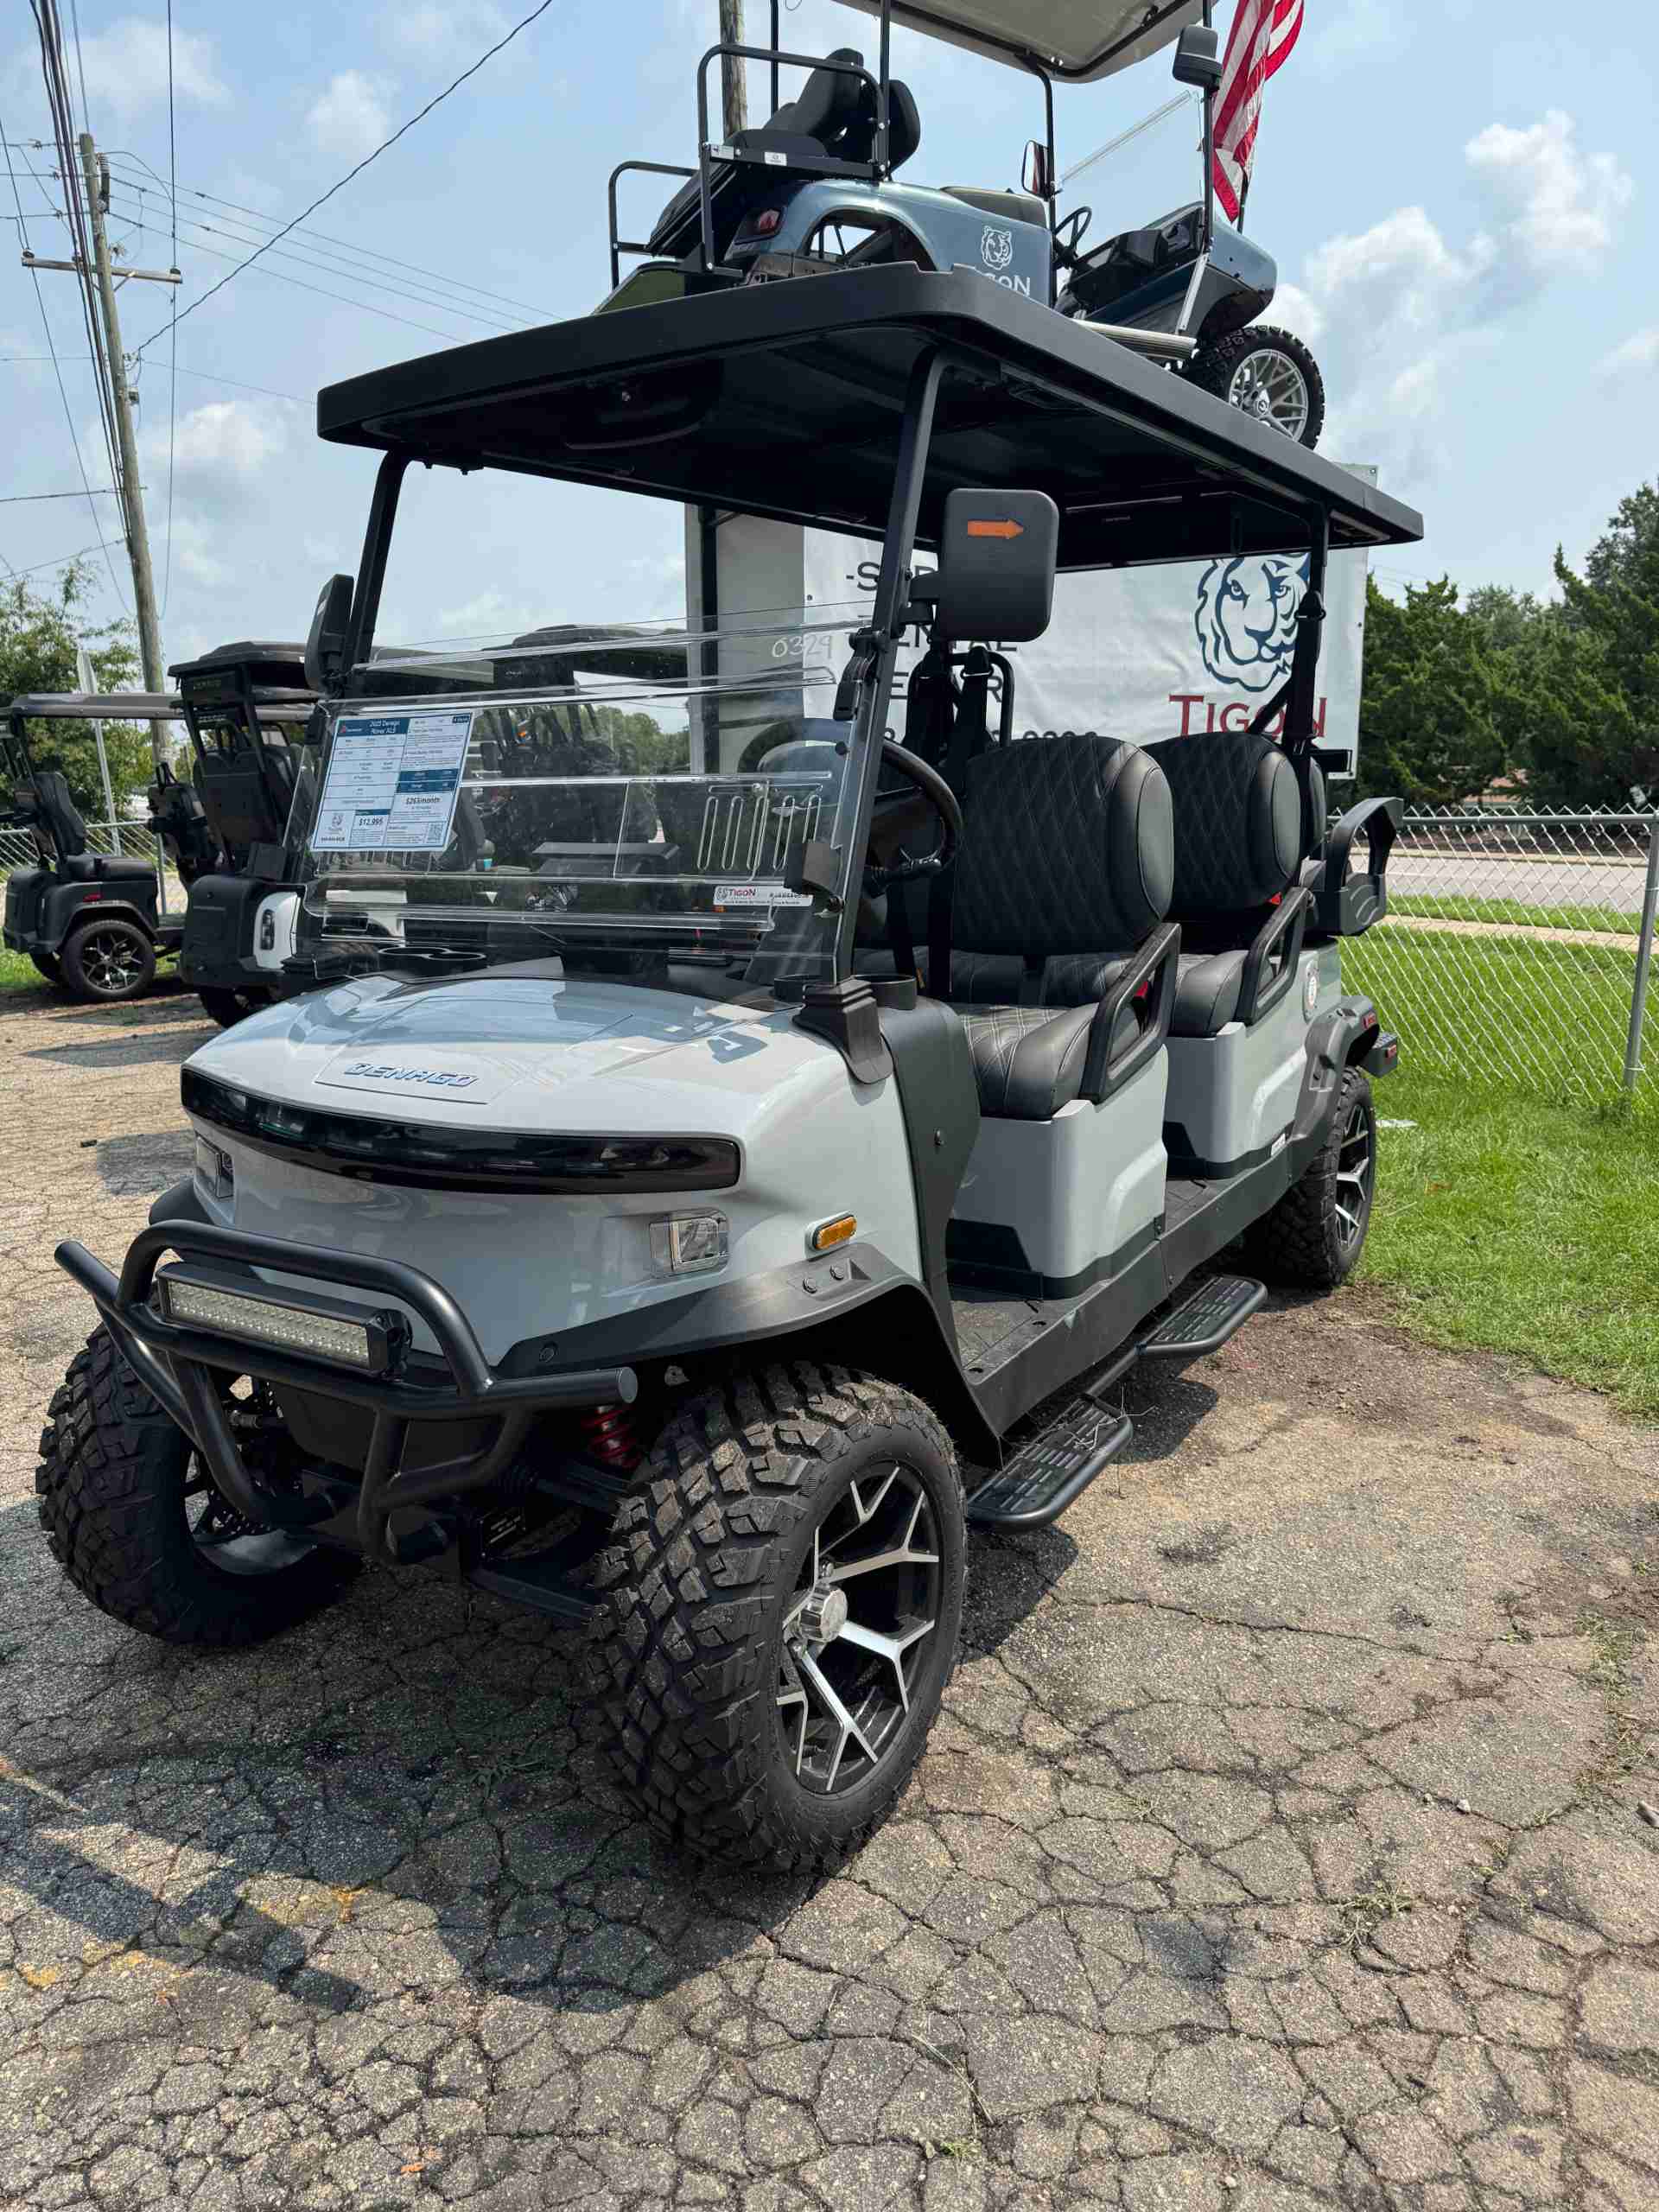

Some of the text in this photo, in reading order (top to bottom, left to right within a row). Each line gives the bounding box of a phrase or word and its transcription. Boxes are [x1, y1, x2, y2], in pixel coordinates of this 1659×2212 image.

[772, 636, 832, 658] 0329
[728, 887, 756, 897] TIGON
[344, 1062, 480, 1088] DENAGO
